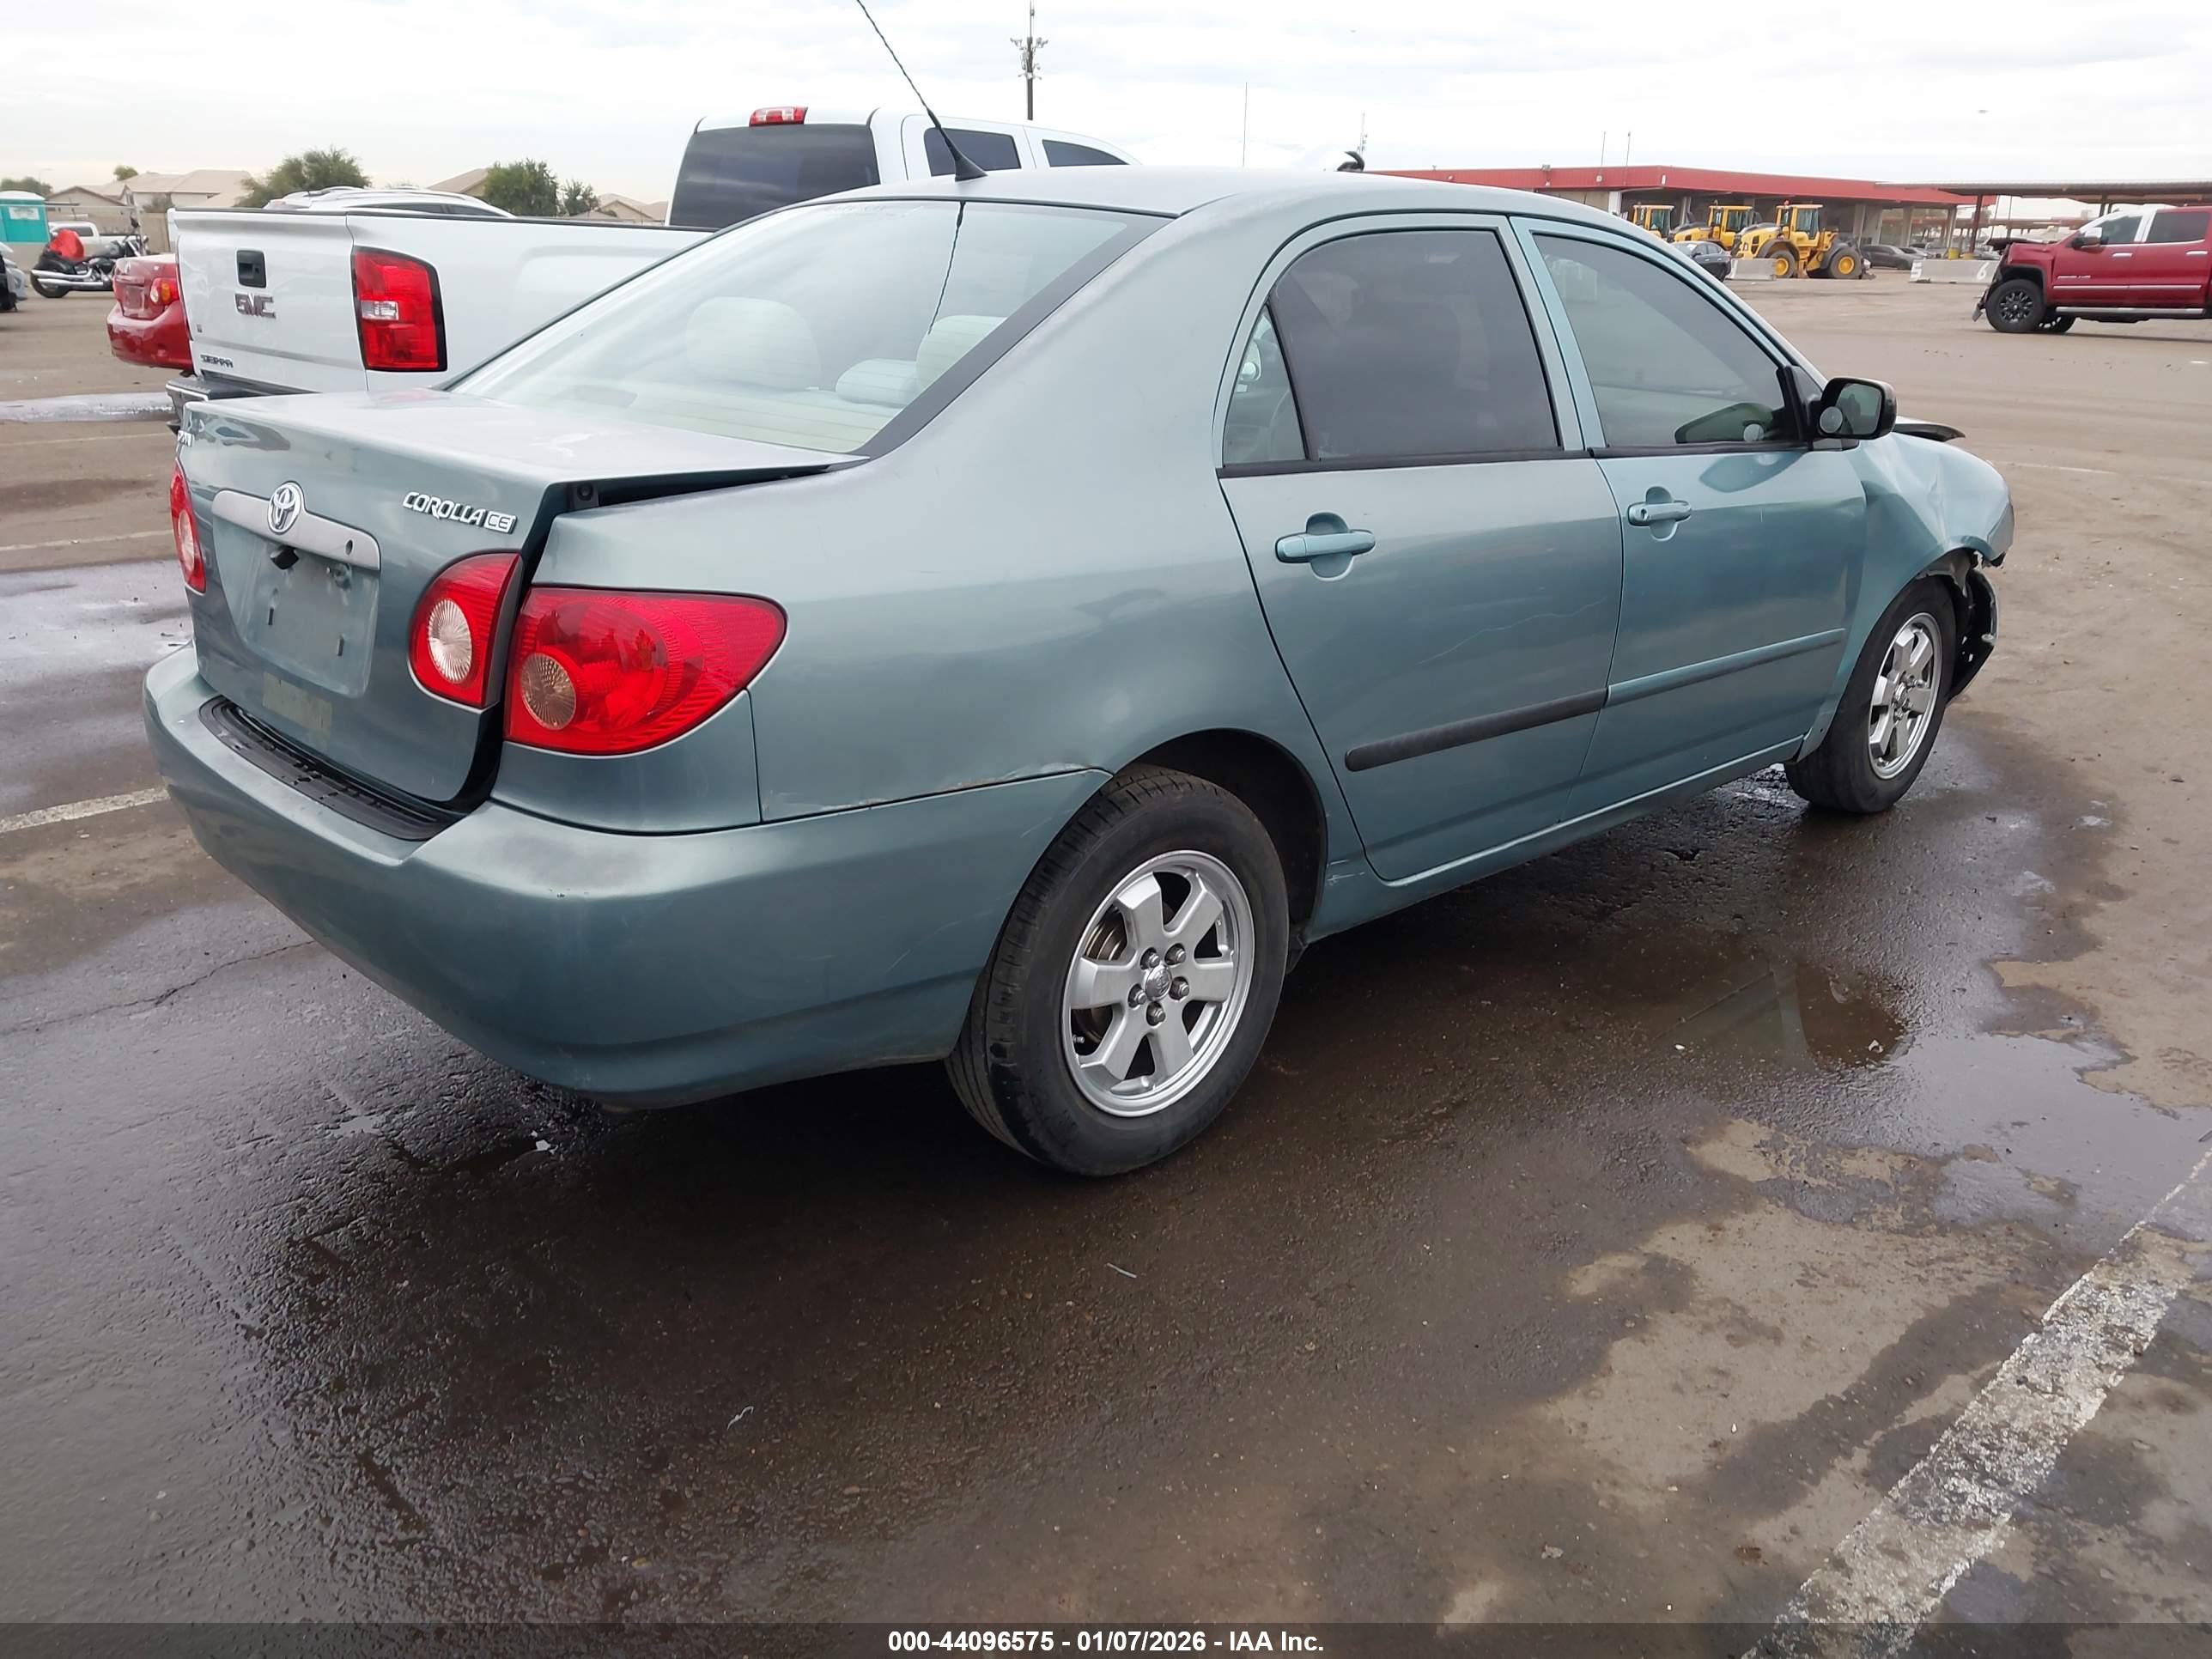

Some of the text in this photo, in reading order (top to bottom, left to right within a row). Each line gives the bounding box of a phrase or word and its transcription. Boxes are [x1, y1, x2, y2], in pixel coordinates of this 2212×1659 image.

[1977, 262, 1990, 280] 6
[234, 293, 276, 319] GMC
[403, 491, 514, 532] COROLLA CE
